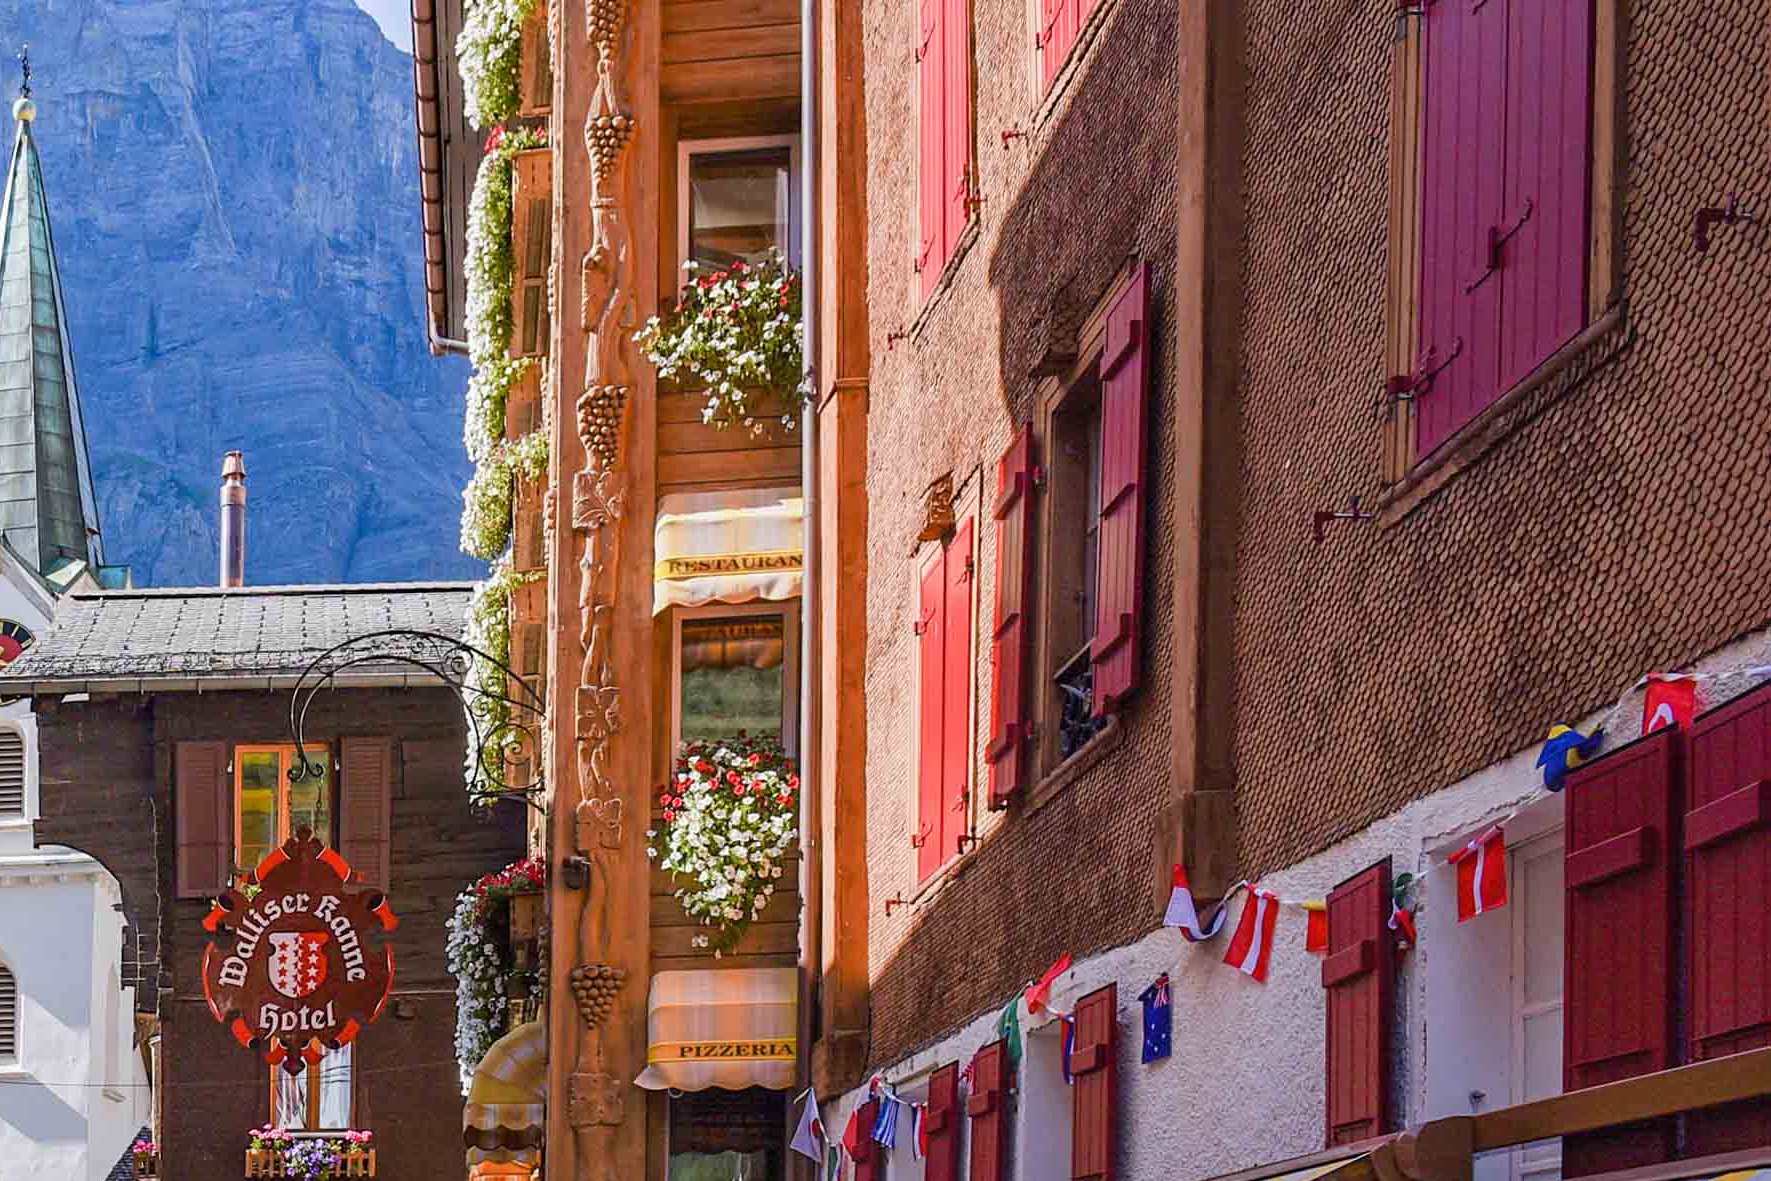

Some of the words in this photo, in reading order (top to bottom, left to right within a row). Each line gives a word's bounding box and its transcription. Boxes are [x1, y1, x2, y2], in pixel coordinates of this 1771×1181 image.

[667, 553, 804, 574] RESTAURAN
[217, 892, 310, 989] Walliser
[313, 894, 367, 983] Kanne
[259, 1000, 337, 1040] Hotel
[678, 1043, 794, 1058] PIZZERIA
